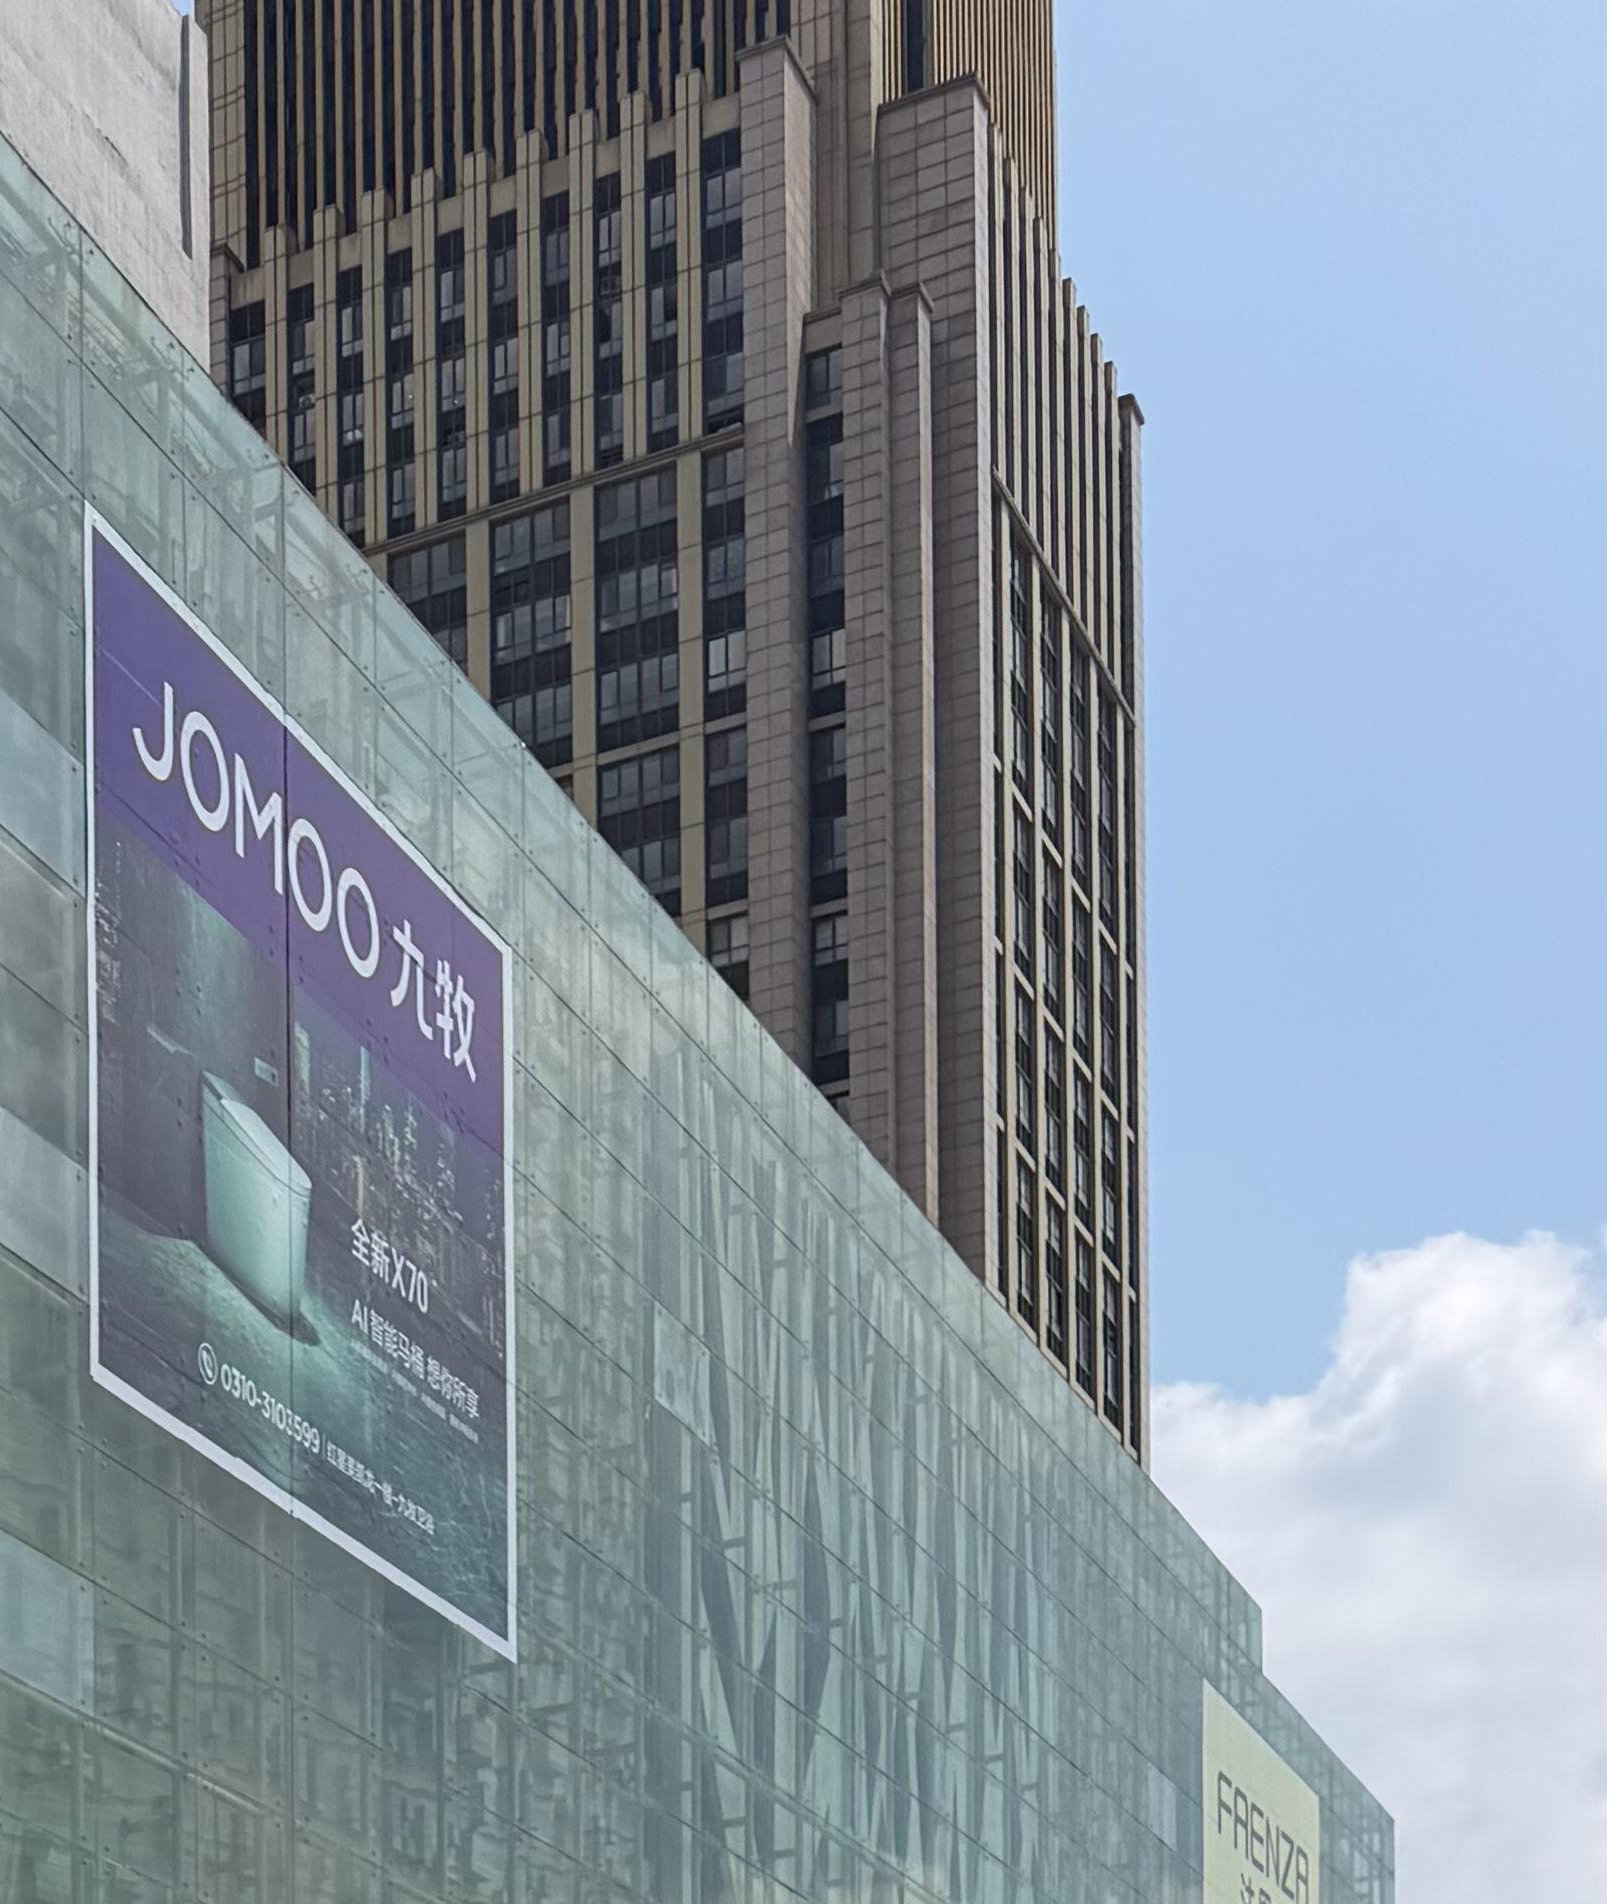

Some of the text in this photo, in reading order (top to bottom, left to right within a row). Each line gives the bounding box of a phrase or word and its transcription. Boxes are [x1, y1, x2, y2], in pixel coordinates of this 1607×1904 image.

[132, 682, 477, 1083] JOMOO 九牧
[220, 1363, 320, 1454] 0310-3103599
